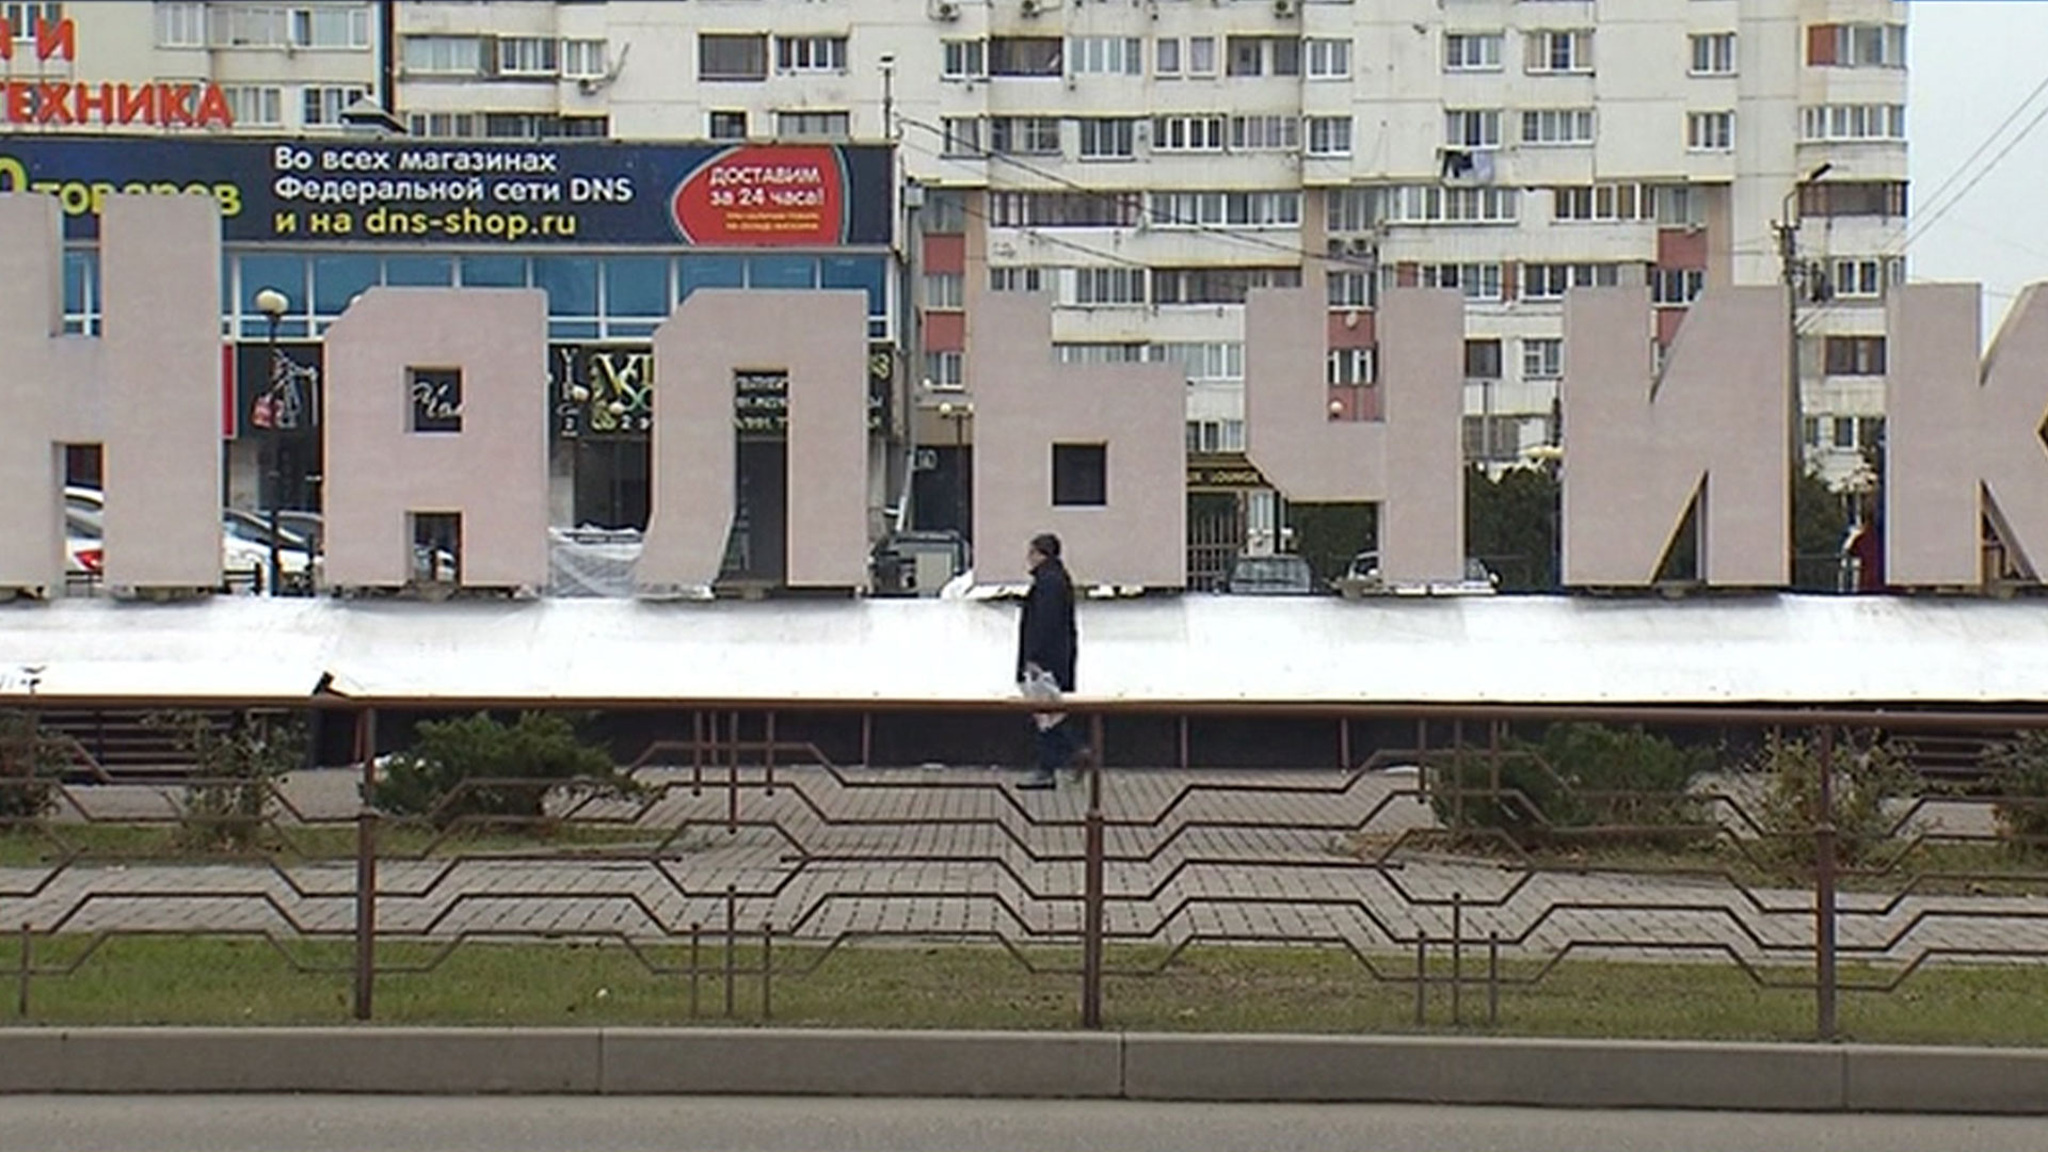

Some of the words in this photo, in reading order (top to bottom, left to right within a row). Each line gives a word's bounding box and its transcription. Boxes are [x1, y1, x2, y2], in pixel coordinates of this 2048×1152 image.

[0, 81, 234, 128] ЕХНИКА
[274, 146, 312, 170] Во
[323, 150, 390, 171] всех
[399, 149, 557, 172] магазинах
[274, 175, 484, 204] Федеральной
[493, 181, 560, 201] сети
[569, 178, 633, 201] DNS
[709, 167, 820, 186] ДОСТАВИМ
[710, 191, 734, 205] за
[738, 187, 764, 206] 24
[275, 212, 296, 233] и
[309, 212, 352, 234] на
[365, 207, 577, 240] dns-shop.ru
